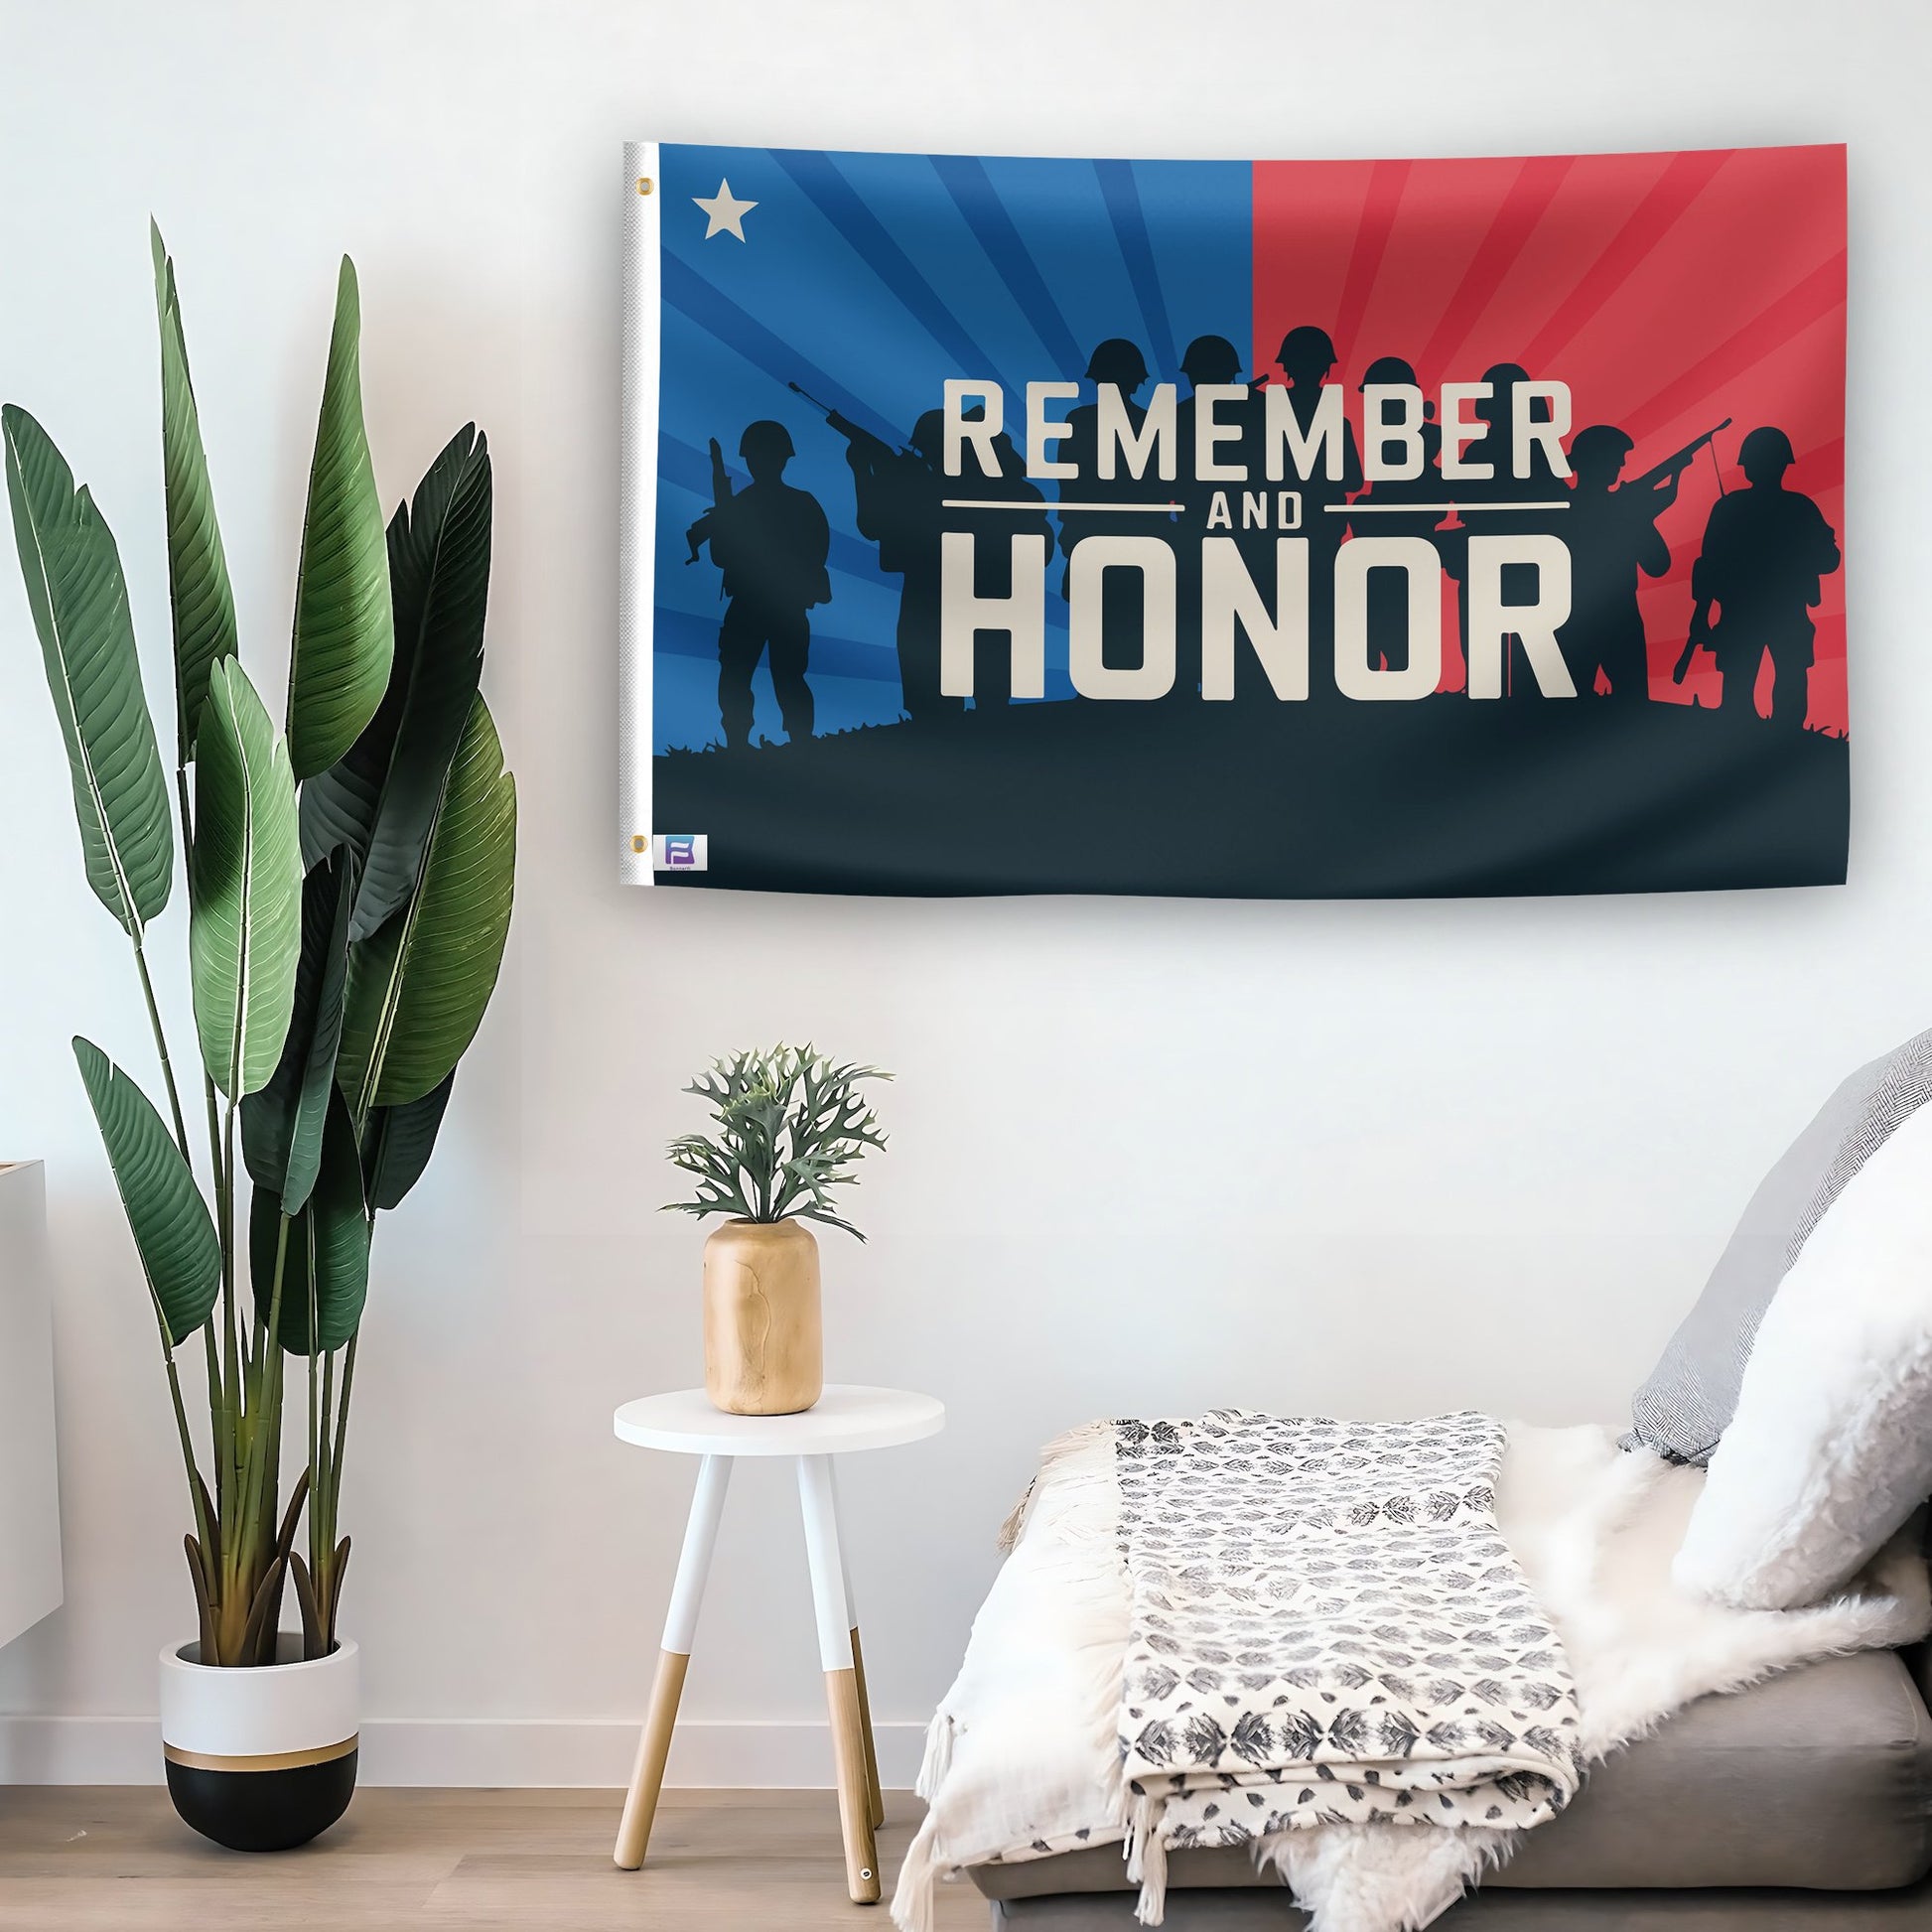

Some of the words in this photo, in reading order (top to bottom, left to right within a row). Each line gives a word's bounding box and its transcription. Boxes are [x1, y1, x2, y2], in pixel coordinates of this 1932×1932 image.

[944, 379, 1572, 482] REMEMBER
[1206, 490, 1302, 530] AND
[941, 532, 1577, 700] HONOR
